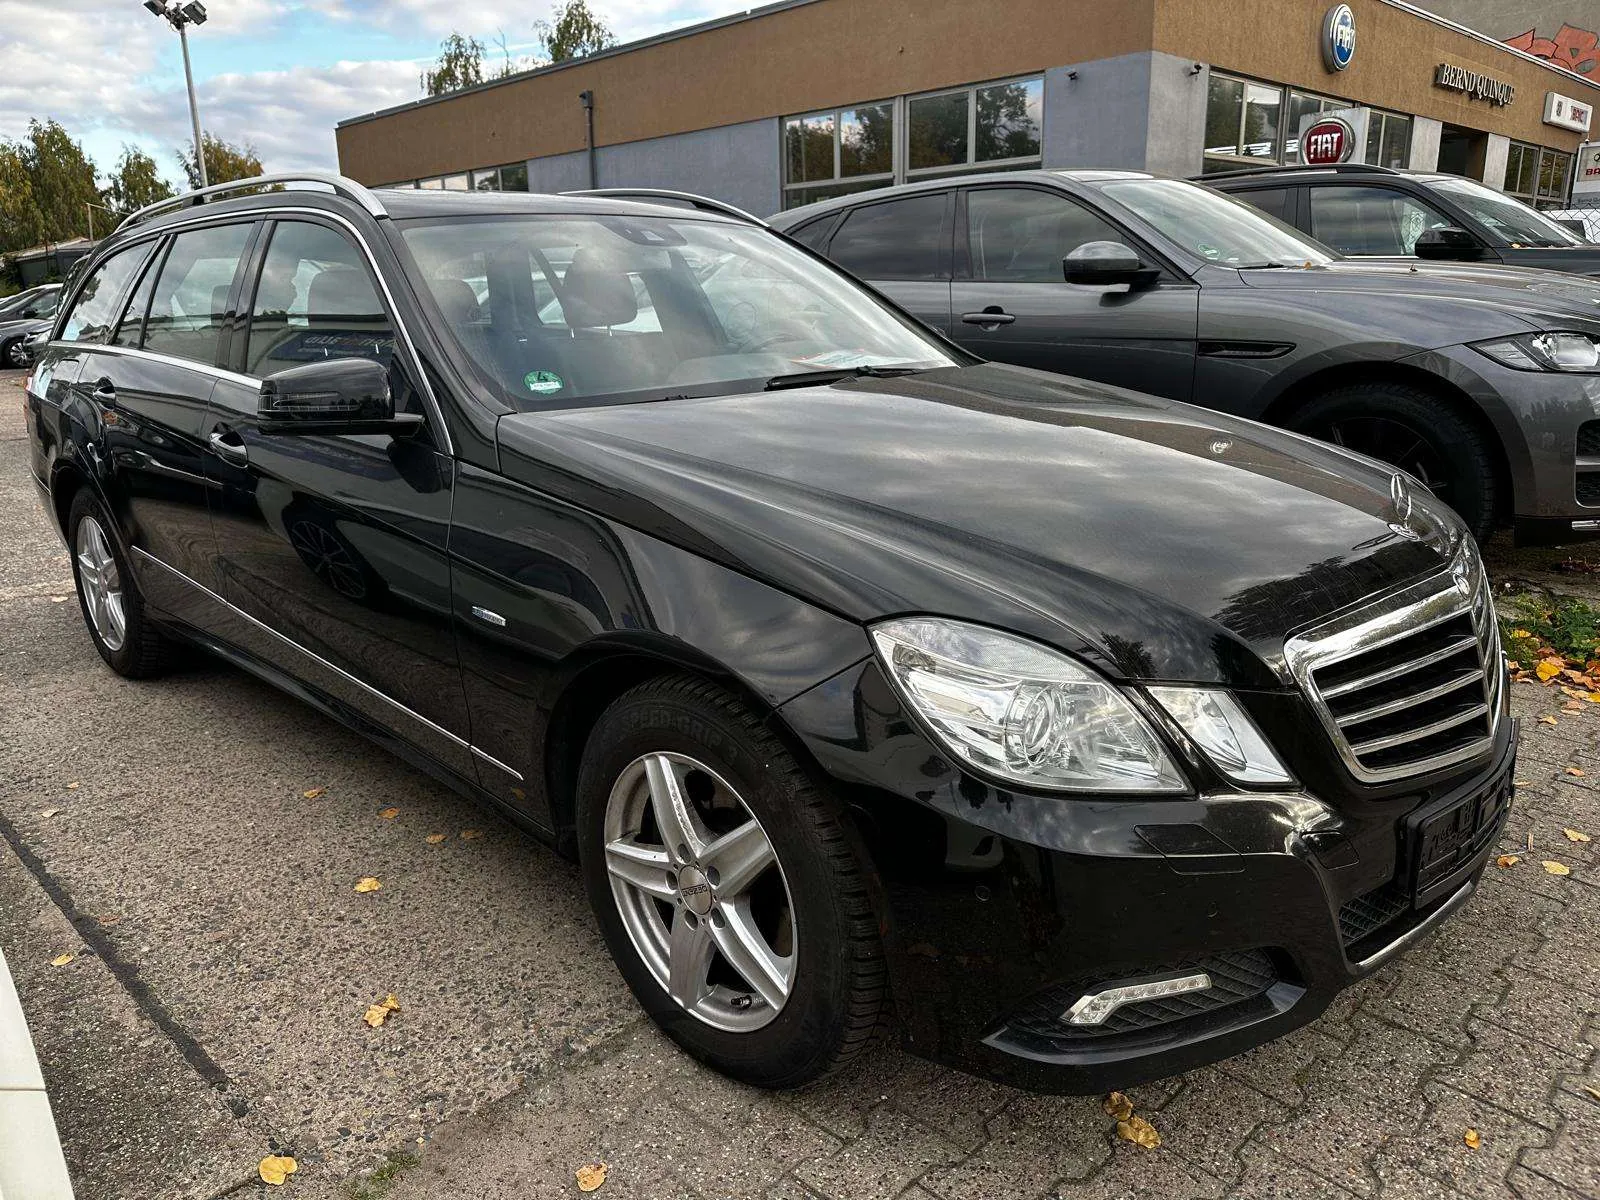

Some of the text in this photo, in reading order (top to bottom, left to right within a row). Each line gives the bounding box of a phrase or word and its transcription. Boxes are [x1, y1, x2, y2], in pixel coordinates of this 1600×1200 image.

[1441, 63, 1515, 106] BERND QUINQUE
[1310, 133, 1341, 159] FIAT
